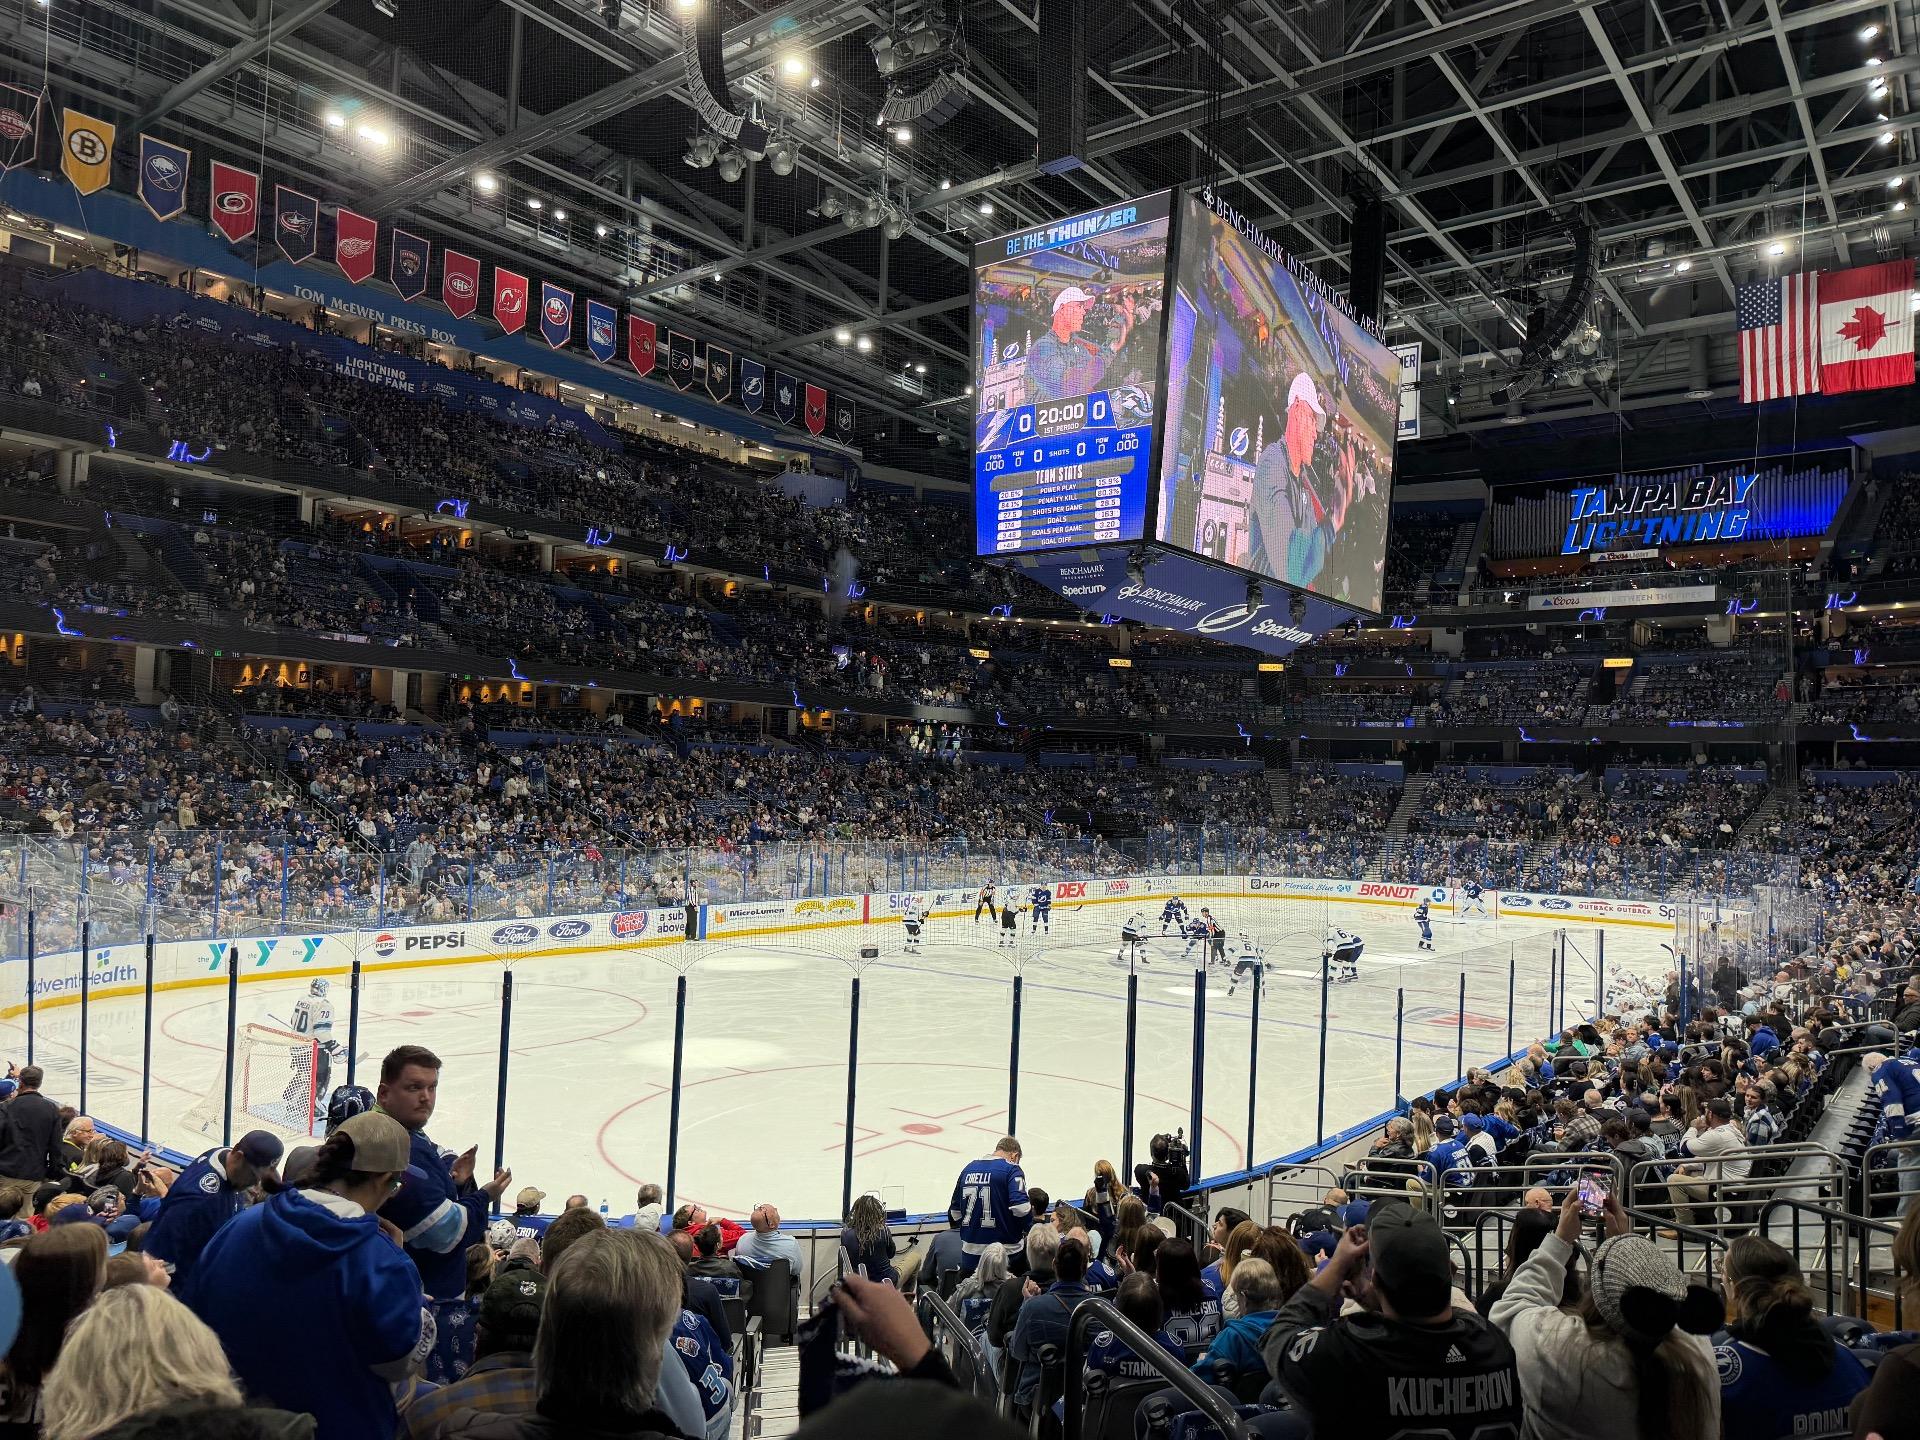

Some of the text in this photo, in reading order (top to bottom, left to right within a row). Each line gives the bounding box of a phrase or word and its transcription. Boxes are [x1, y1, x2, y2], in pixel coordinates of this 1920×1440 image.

[1007, 207, 1136, 255] BE THE THUNDER
[1216, 196, 1387, 346] BENCHMARK INTERNATIONAL ARENA
[293, 285, 456, 345] TOM McEWEN PRESS BOX
[346, 356, 406, 380] LIGHTNING
[335, 363, 415, 393] HALL OF FAME
[1038, 403, 1084, 426] 20:00
[1093, 400, 1106, 420] 0
[1019, 414, 1031, 433] 0
[1056, 423, 1079, 432] PERIOD
[1076, 442, 1086, 457] 0
[1098, 444, 1106, 455] 0
[1114, 438, 1139, 452] .000
[1034, 449, 1043, 463] 0
[1049, 449, 1070, 457] SHOTS
[982, 459, 1005, 472] .000
[1015, 457, 1022, 467] 0
[1035, 464, 1083, 485] TEAM STATS
[1040, 486, 1061, 494] POWER
[1038, 496, 1064, 505] PENALTY
[1570, 473, 1760, 521] TAMPA BAY
[1032, 508, 1052, 516] SHOTS
[1065, 504, 1083, 512] GAME
[1047, 516, 1067, 524] GOALS
[1041, 538, 1057, 546] GOAL
[1606, 552, 1629, 560] Coors
[1060, 564, 1105, 576] BENCHMARK
[1062, 585, 1104, 597] Spectrum
[1138, 587, 1206, 612] BENCHMARK
[1552, 596, 1580, 606] Coors
[1131, 598, 1189, 617] INTERNATIONAL
[1251, 618, 1314, 643] Spectrum
[1056, 881, 1088, 898] DEX
[1284, 882, 1314, 890] Florida
[1316, 882, 1334, 891] Blue
[1357, 884, 1420, 899] BRANDT
[1505, 896, 1527, 906] Ford
[1544, 900, 1566, 909] Ford
[668, 910, 684, 921] sub
[729, 907, 785, 917] MicroLumen
[1616, 906, 1652, 914] OUTBACK
[614, 912, 644, 925] Jersey
[556, 923, 583, 937] Ford
[616, 920, 643, 933] Mike's
[657, 923, 685, 933] above
[405, 931, 466, 950] PEPSI
[500, 927, 531, 944] Ford
[321, 1010, 330, 1019] 70
[964, 1172, 991, 1185] CIRELLI
[962, 1186, 996, 1229] 71
[1445, 1355, 1467, 1363] adidas
[1387, 1367, 1513, 1416] KUCHEROV
